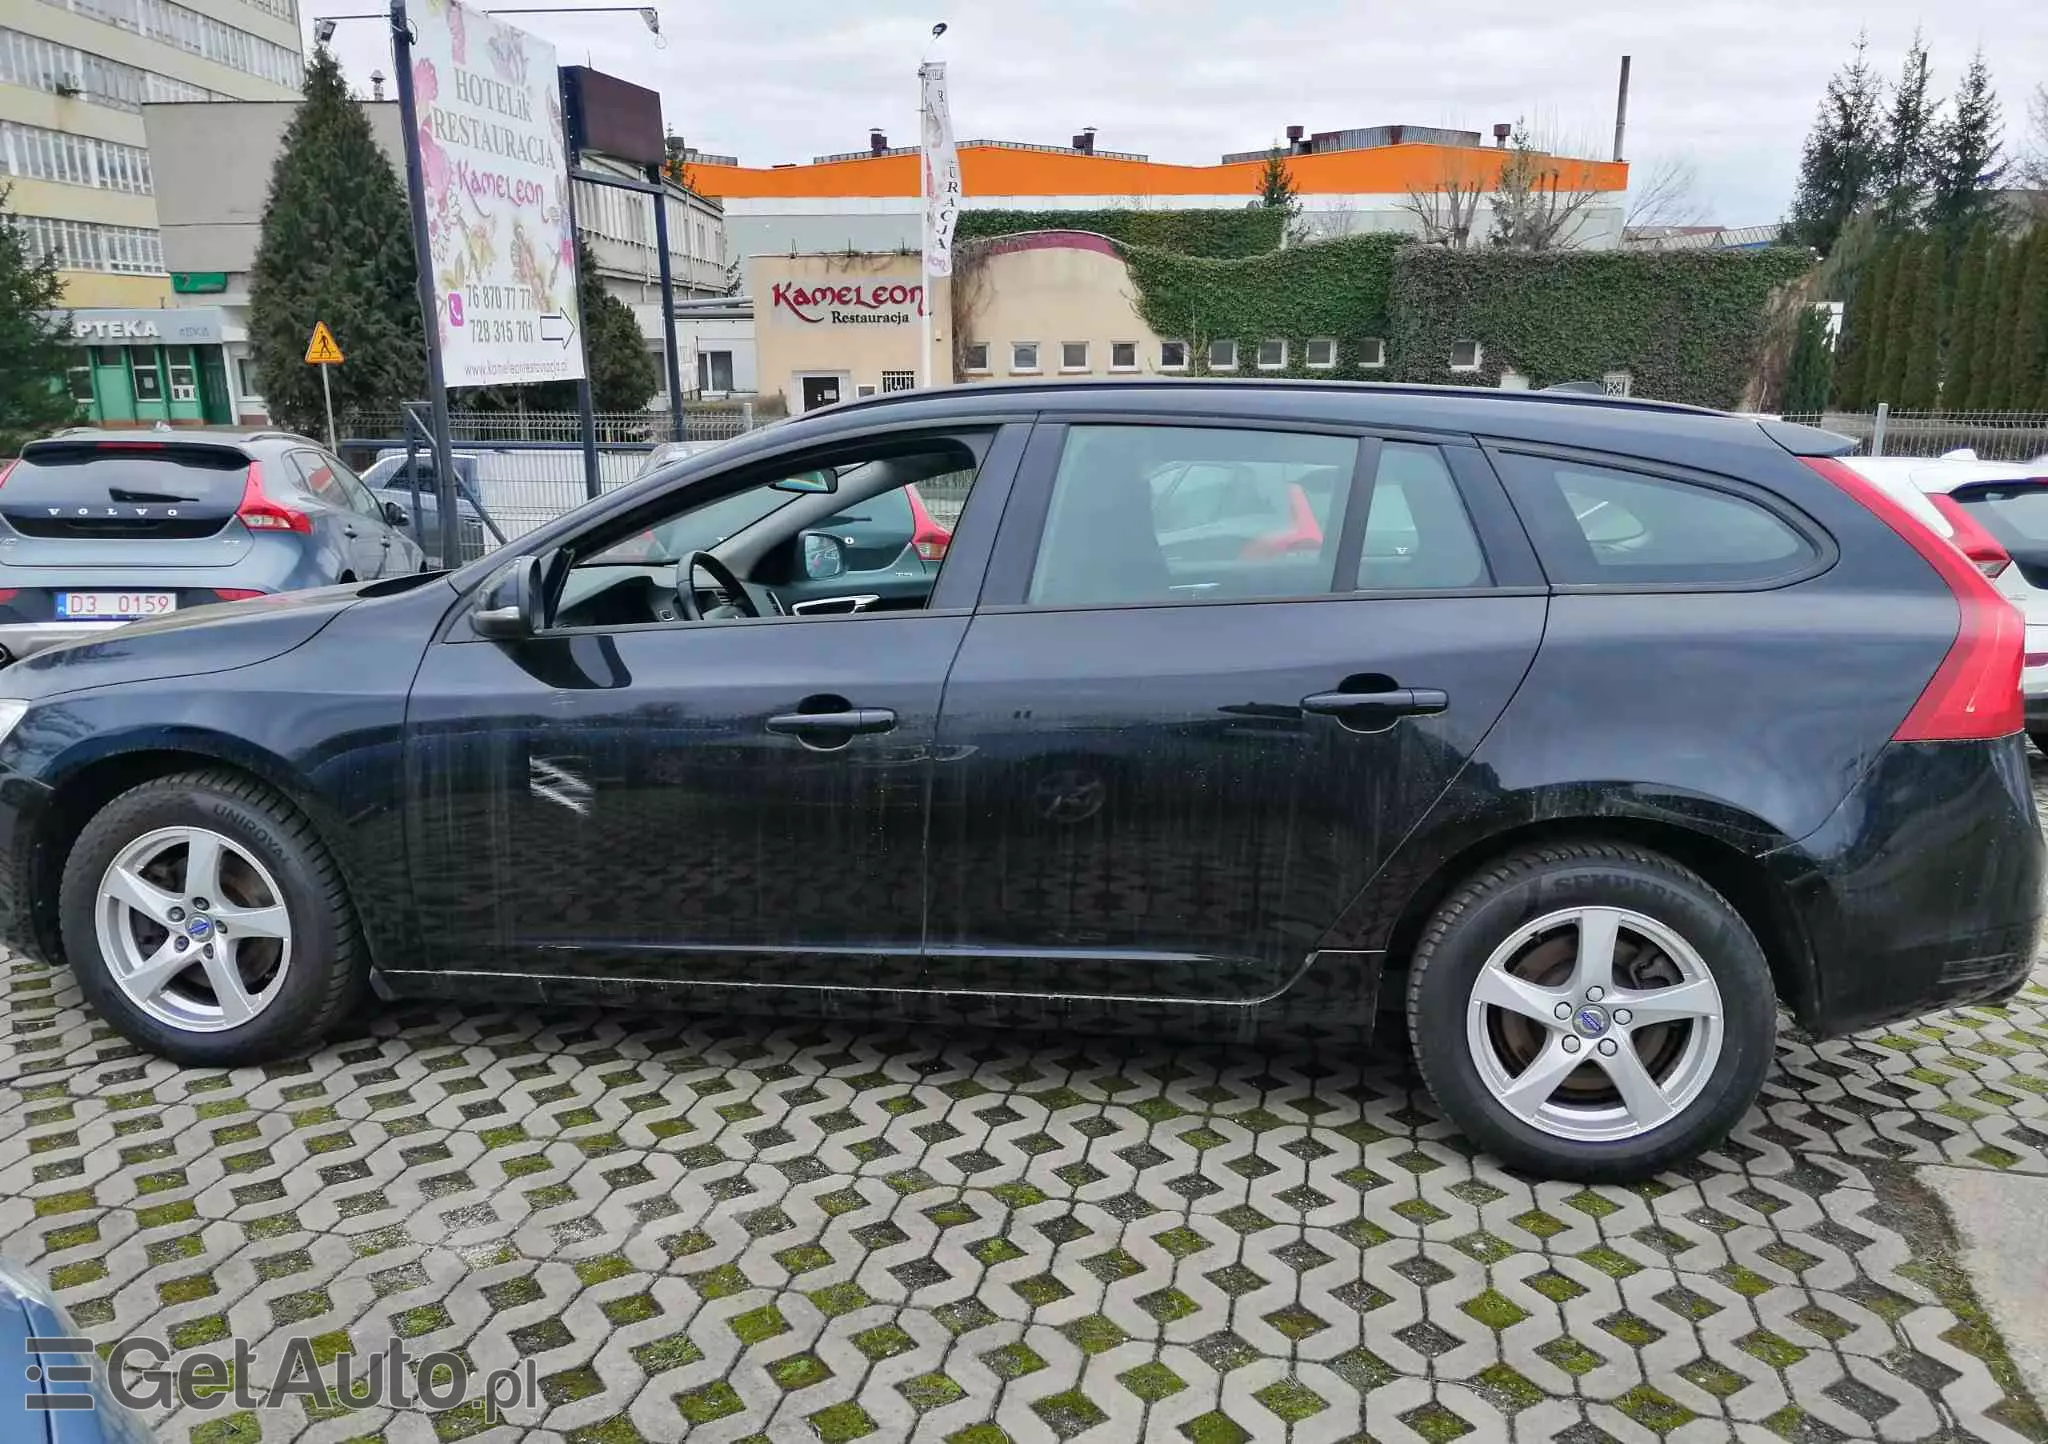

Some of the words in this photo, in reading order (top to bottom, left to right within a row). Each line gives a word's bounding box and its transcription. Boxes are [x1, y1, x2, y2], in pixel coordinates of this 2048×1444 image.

[432, 105, 556, 170] RESTAURACJA
[466, 284, 479, 309] 76
[483, 285, 502, 309] 870
[505, 287, 516, 310] 77
[520, 287, 531, 311] 77
[831, 310, 909, 325] Restauracja
[471, 319, 490, 344] 728
[494, 320, 513, 343] 315
[516, 320, 533, 343] 701
[48, 507, 178, 517] VOLVO
[71, 595, 97, 613] D3
[118, 595, 169, 613] 0159
